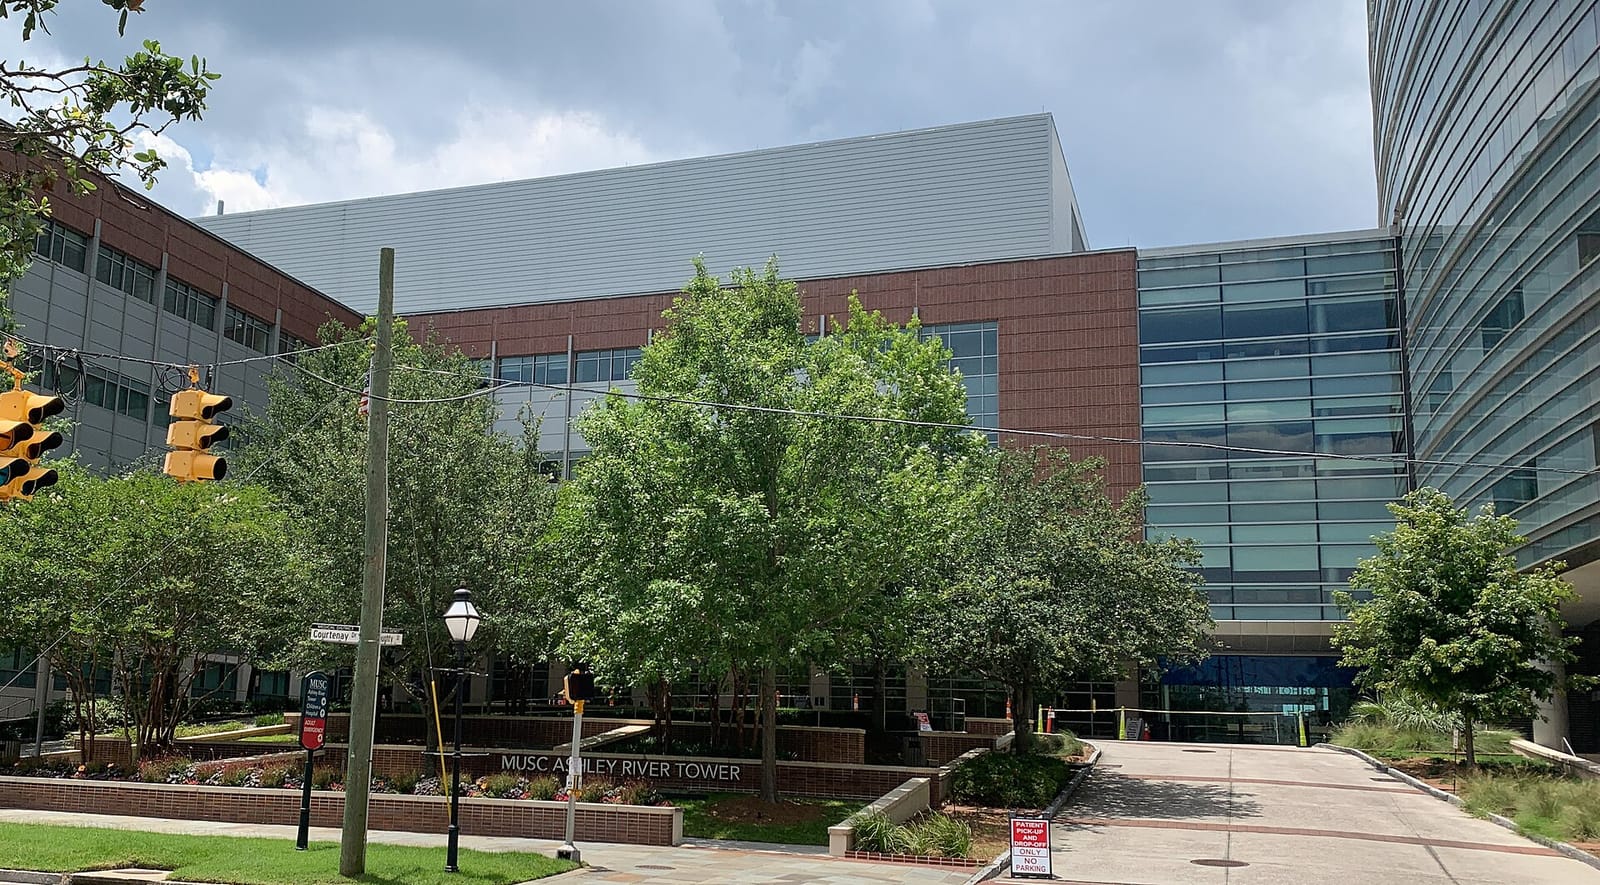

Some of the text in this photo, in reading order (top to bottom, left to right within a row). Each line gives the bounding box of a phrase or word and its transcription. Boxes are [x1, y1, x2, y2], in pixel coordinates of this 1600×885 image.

[313, 630, 349, 640] Courtenay
[309, 679, 328, 689] MUSC
[501, 755, 549, 771] MUSC
[622, 759, 670, 777] RIVER
[675, 762, 740, 780] TOWER
[1015, 864, 1046, 872] PARKING
